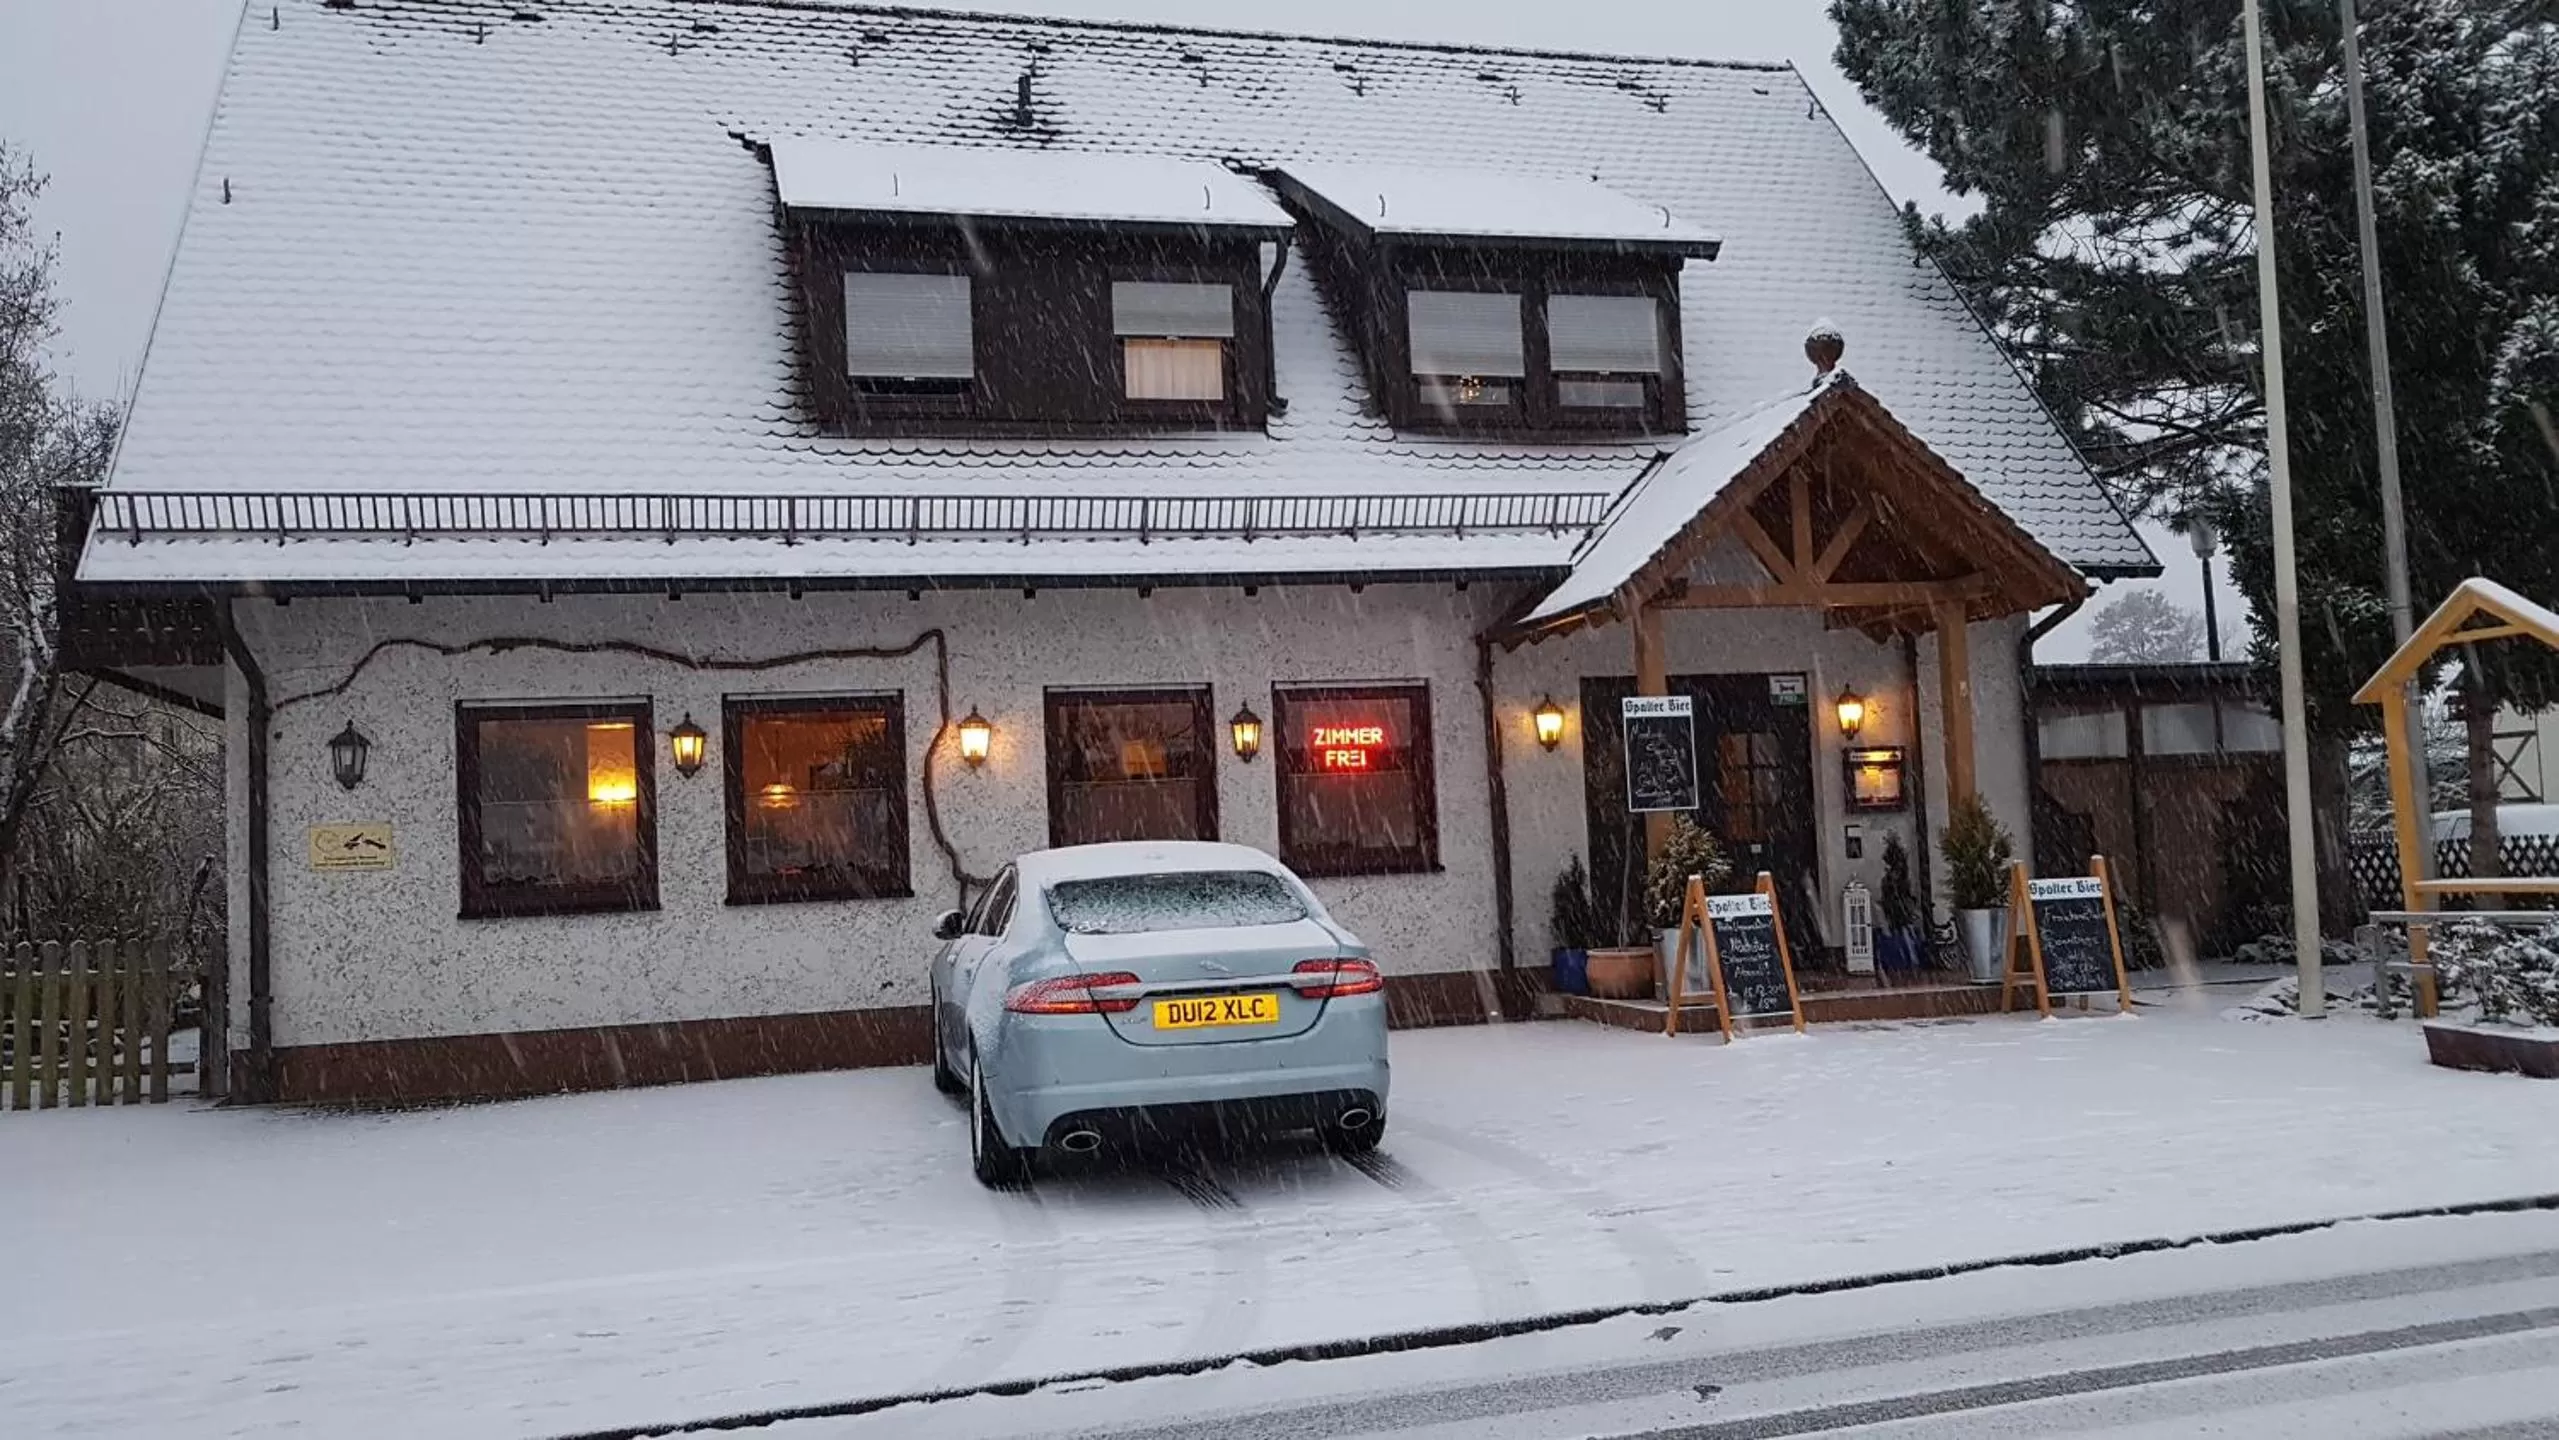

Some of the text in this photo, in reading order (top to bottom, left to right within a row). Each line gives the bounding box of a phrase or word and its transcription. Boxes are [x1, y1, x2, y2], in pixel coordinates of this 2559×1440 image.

[1668, 699, 1690, 713] Bier
[1313, 727, 1383, 746] ZIMMER
[1325, 749, 1366, 767] FREI
[2076, 880, 2101, 894] Bier
[1168, 1001, 1217, 1024] DU12
[1224, 999, 1265, 1019] XLC
